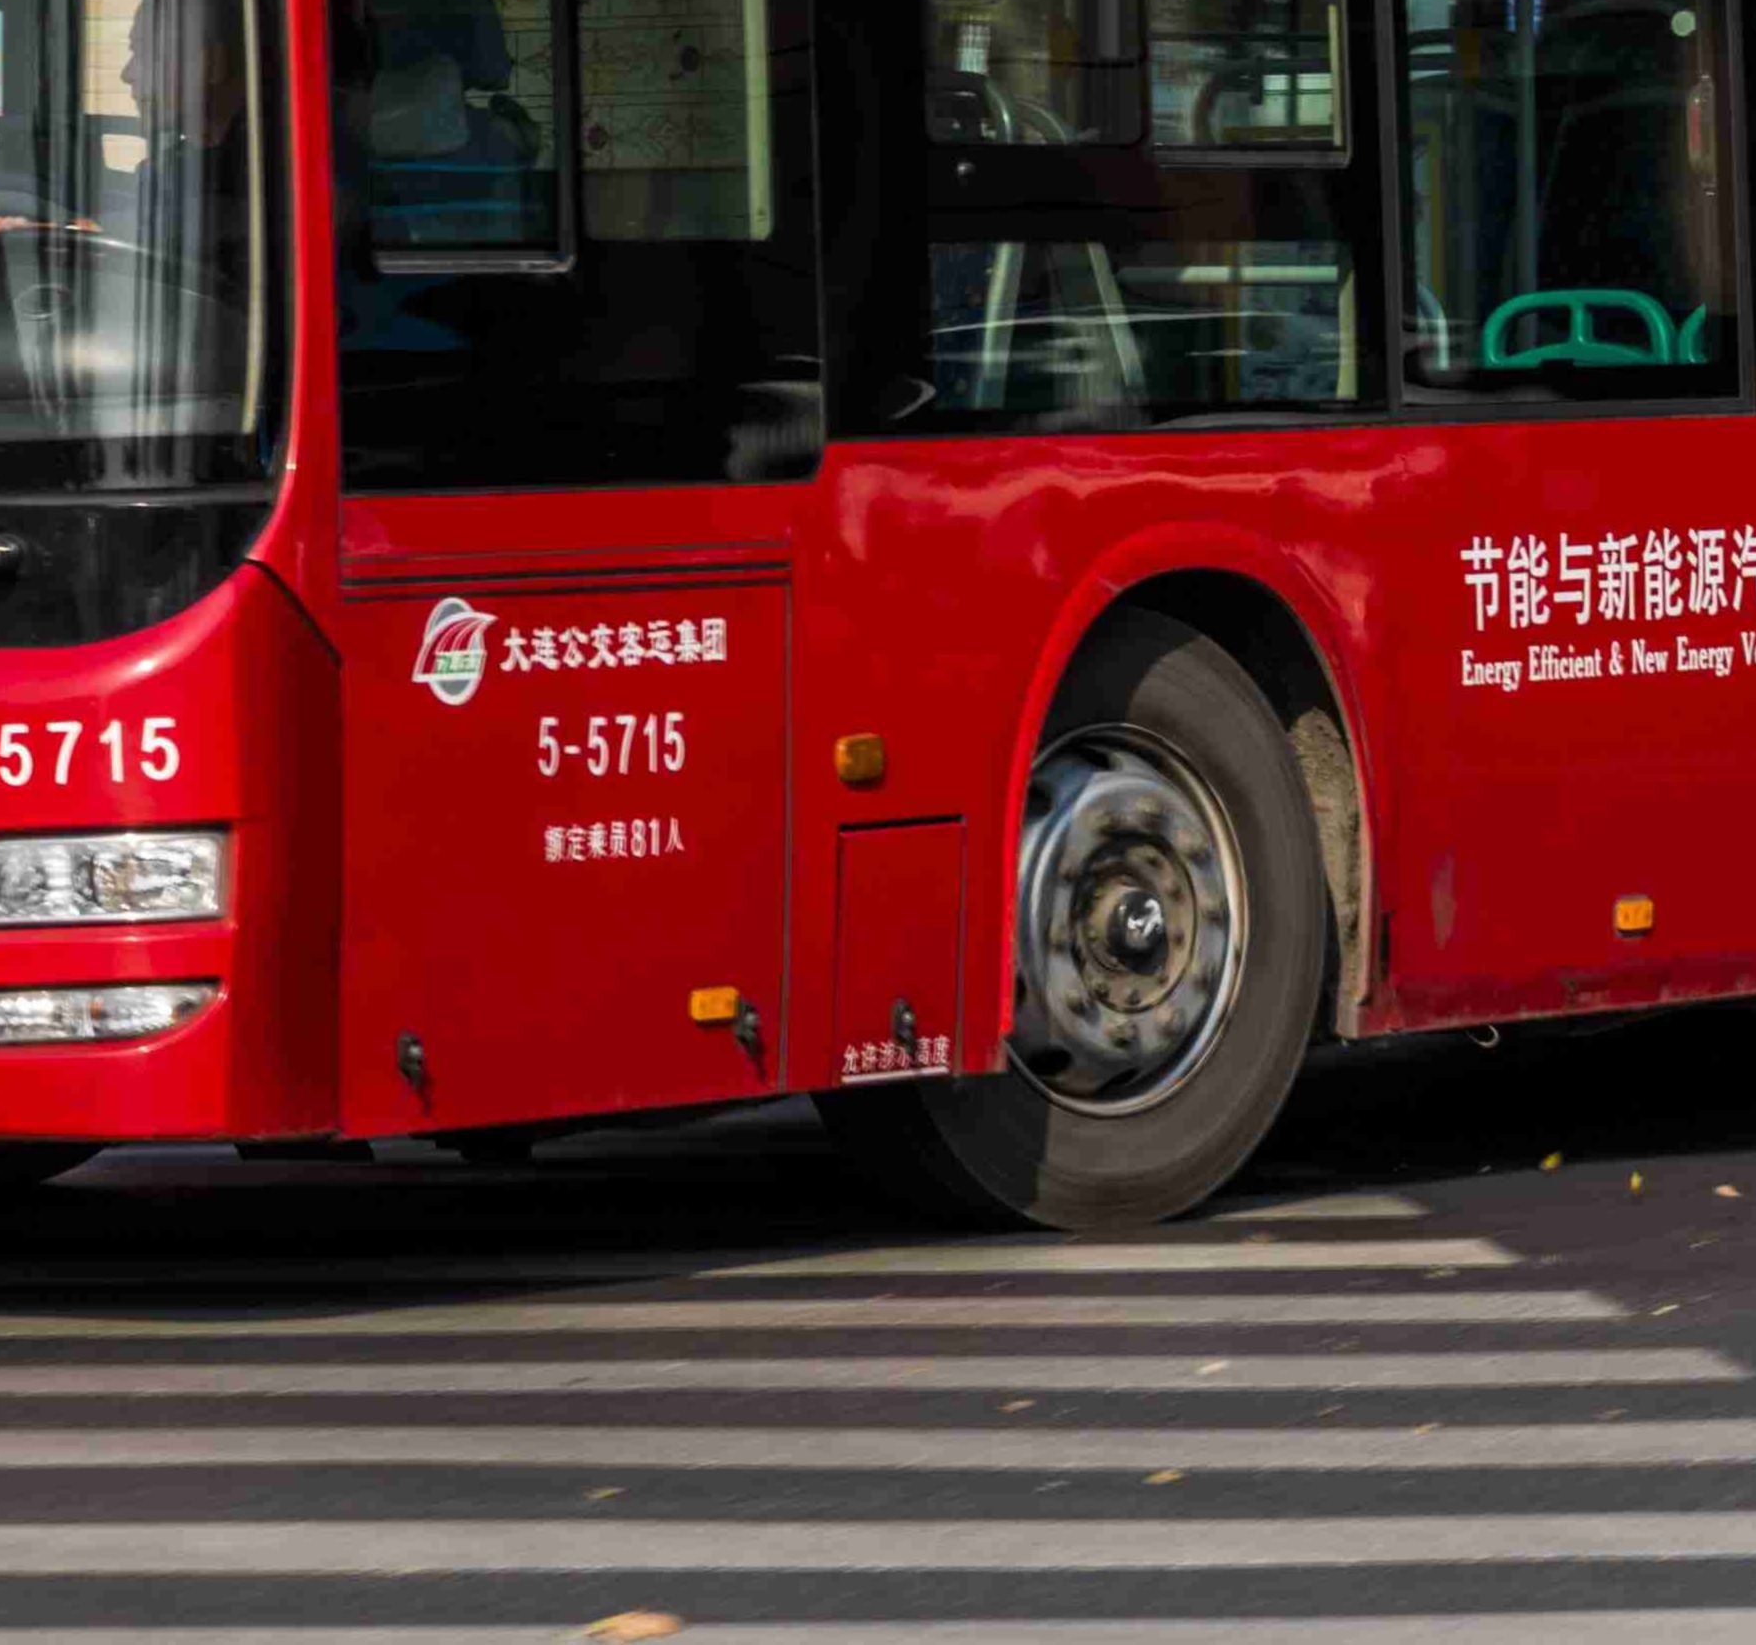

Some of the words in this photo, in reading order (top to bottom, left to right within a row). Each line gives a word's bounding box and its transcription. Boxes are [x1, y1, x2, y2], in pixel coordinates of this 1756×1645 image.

[499, 617, 727, 673] 大连公交客运集团
[1461, 649, 1523, 692] Energy
[1528, 643, 1602, 682] Efficient
[1608, 640, 1625, 677] &
[1631, 638, 1669, 674] New
[1676, 635, 1734, 678] Energy
[536, 711, 687, 777] 5-5715
